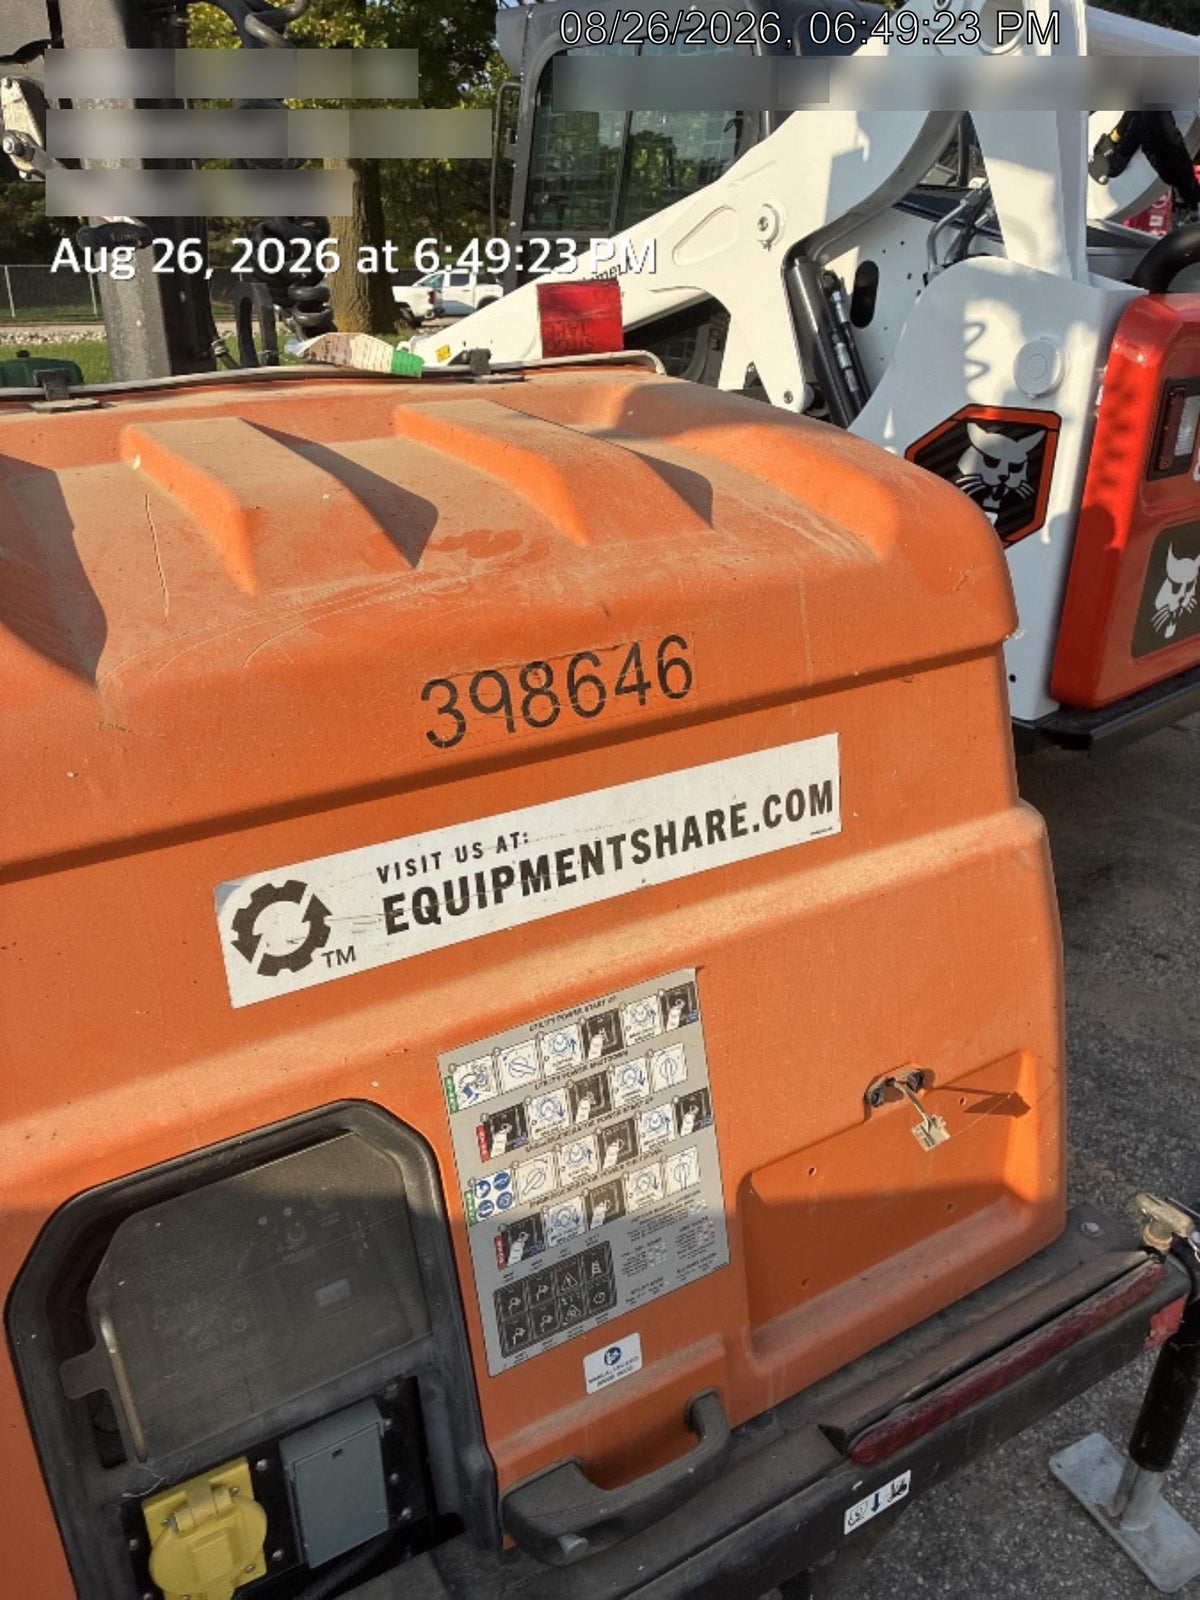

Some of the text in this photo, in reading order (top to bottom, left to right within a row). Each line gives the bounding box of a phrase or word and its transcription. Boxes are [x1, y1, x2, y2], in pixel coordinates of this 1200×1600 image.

[420, 634, 694, 749] 398646
[376, 830, 530, 884] VISIT US AT:
[382, 780, 835, 936] EQUIPMENTSHARE.COM
[322, 945, 357, 969] TM
